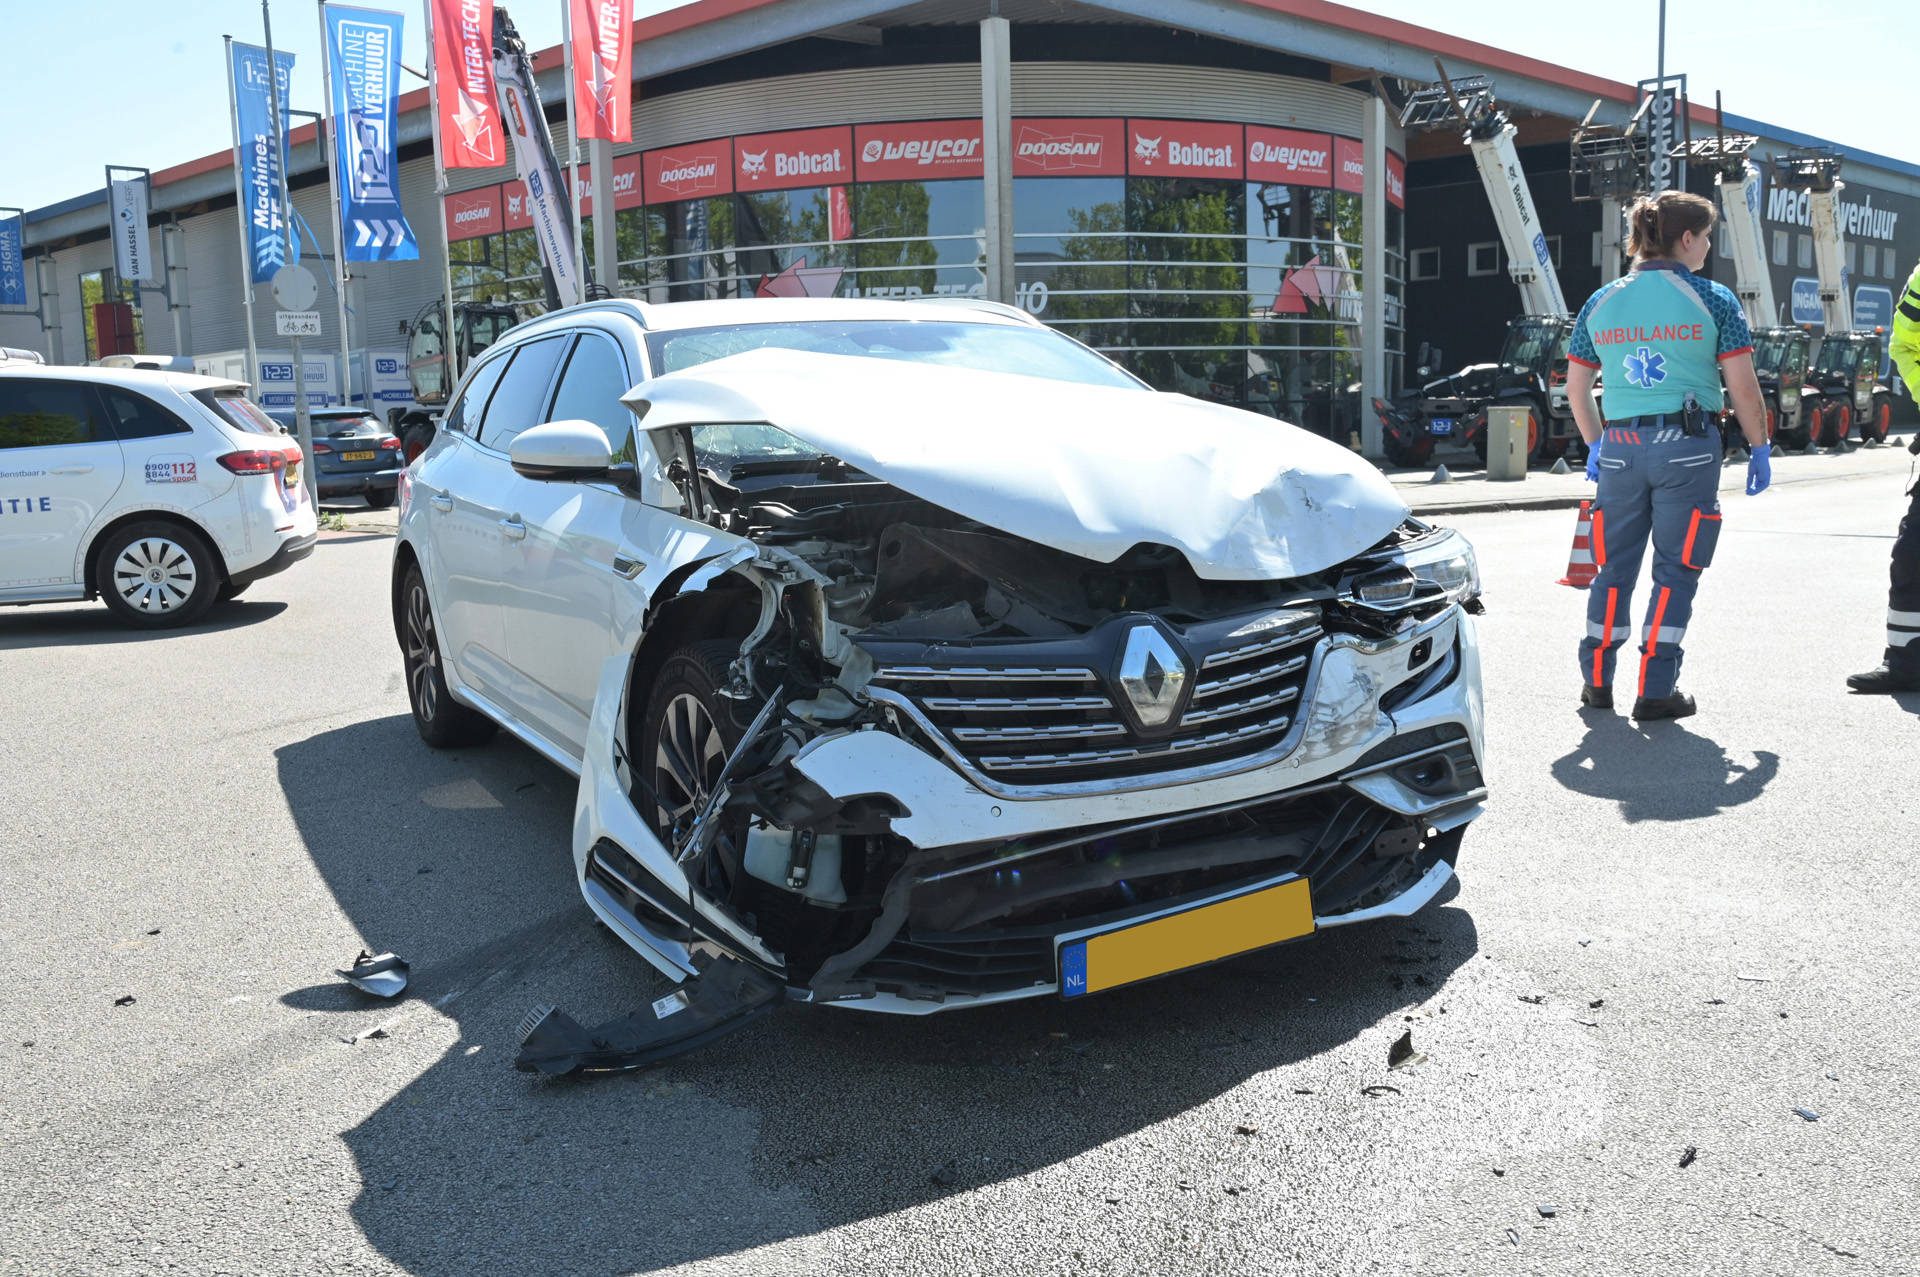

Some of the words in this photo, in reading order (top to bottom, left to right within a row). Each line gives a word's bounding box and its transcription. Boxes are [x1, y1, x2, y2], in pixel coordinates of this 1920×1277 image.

[364, 31, 385, 115] VERHUUR
[882, 138, 980, 165] weycor
[1018, 142, 1099, 156] DOOSAN
[1168, 141, 1232, 168] Bobcat
[1264, 146, 1327, 170] weycor
[660, 163, 716, 183] DOOSAN
[774, 149, 841, 177] Bobcat
[253, 133, 270, 229] Machines
[455, 206, 490, 224] DOOSAN
[128, 224, 138, 257] HASSEL
[538, 199, 567, 279] Machineverhuur
[1, 230, 13, 273] SIGMA
[131, 260, 140, 275] VAN
[1594, 324, 1704, 345] AMBULANCE
[145, 471, 170, 479] 8844
[171, 463, 196, 474] 112
[1066, 974, 1086, 988] NL
